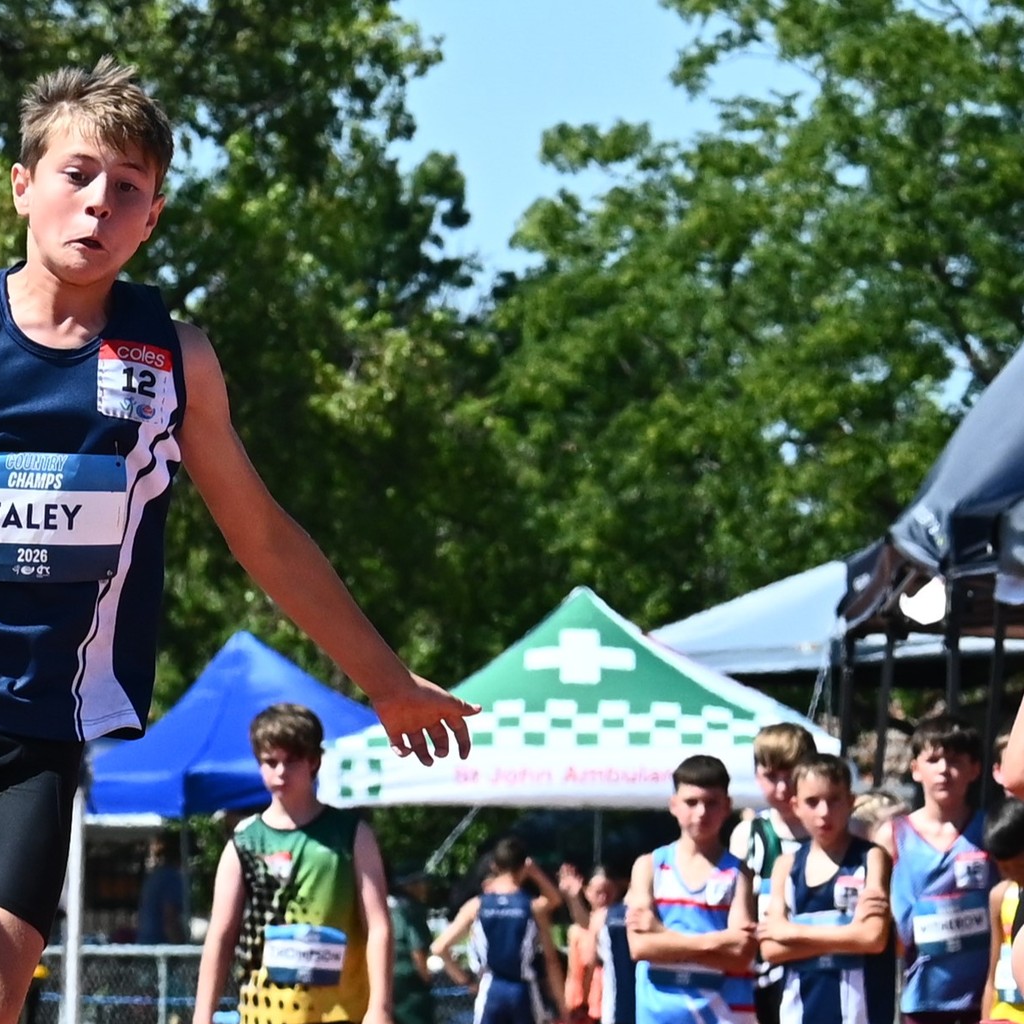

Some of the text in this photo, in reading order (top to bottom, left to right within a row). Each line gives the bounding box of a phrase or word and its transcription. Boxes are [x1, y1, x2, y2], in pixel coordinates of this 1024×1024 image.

[117, 345, 165, 367] coles
[122, 367, 156, 399] 12
[5, 452, 68, 471] COUNTRY
[8, 472, 64, 489] CHAMPS
[17, 548, 48, 563] 2026
